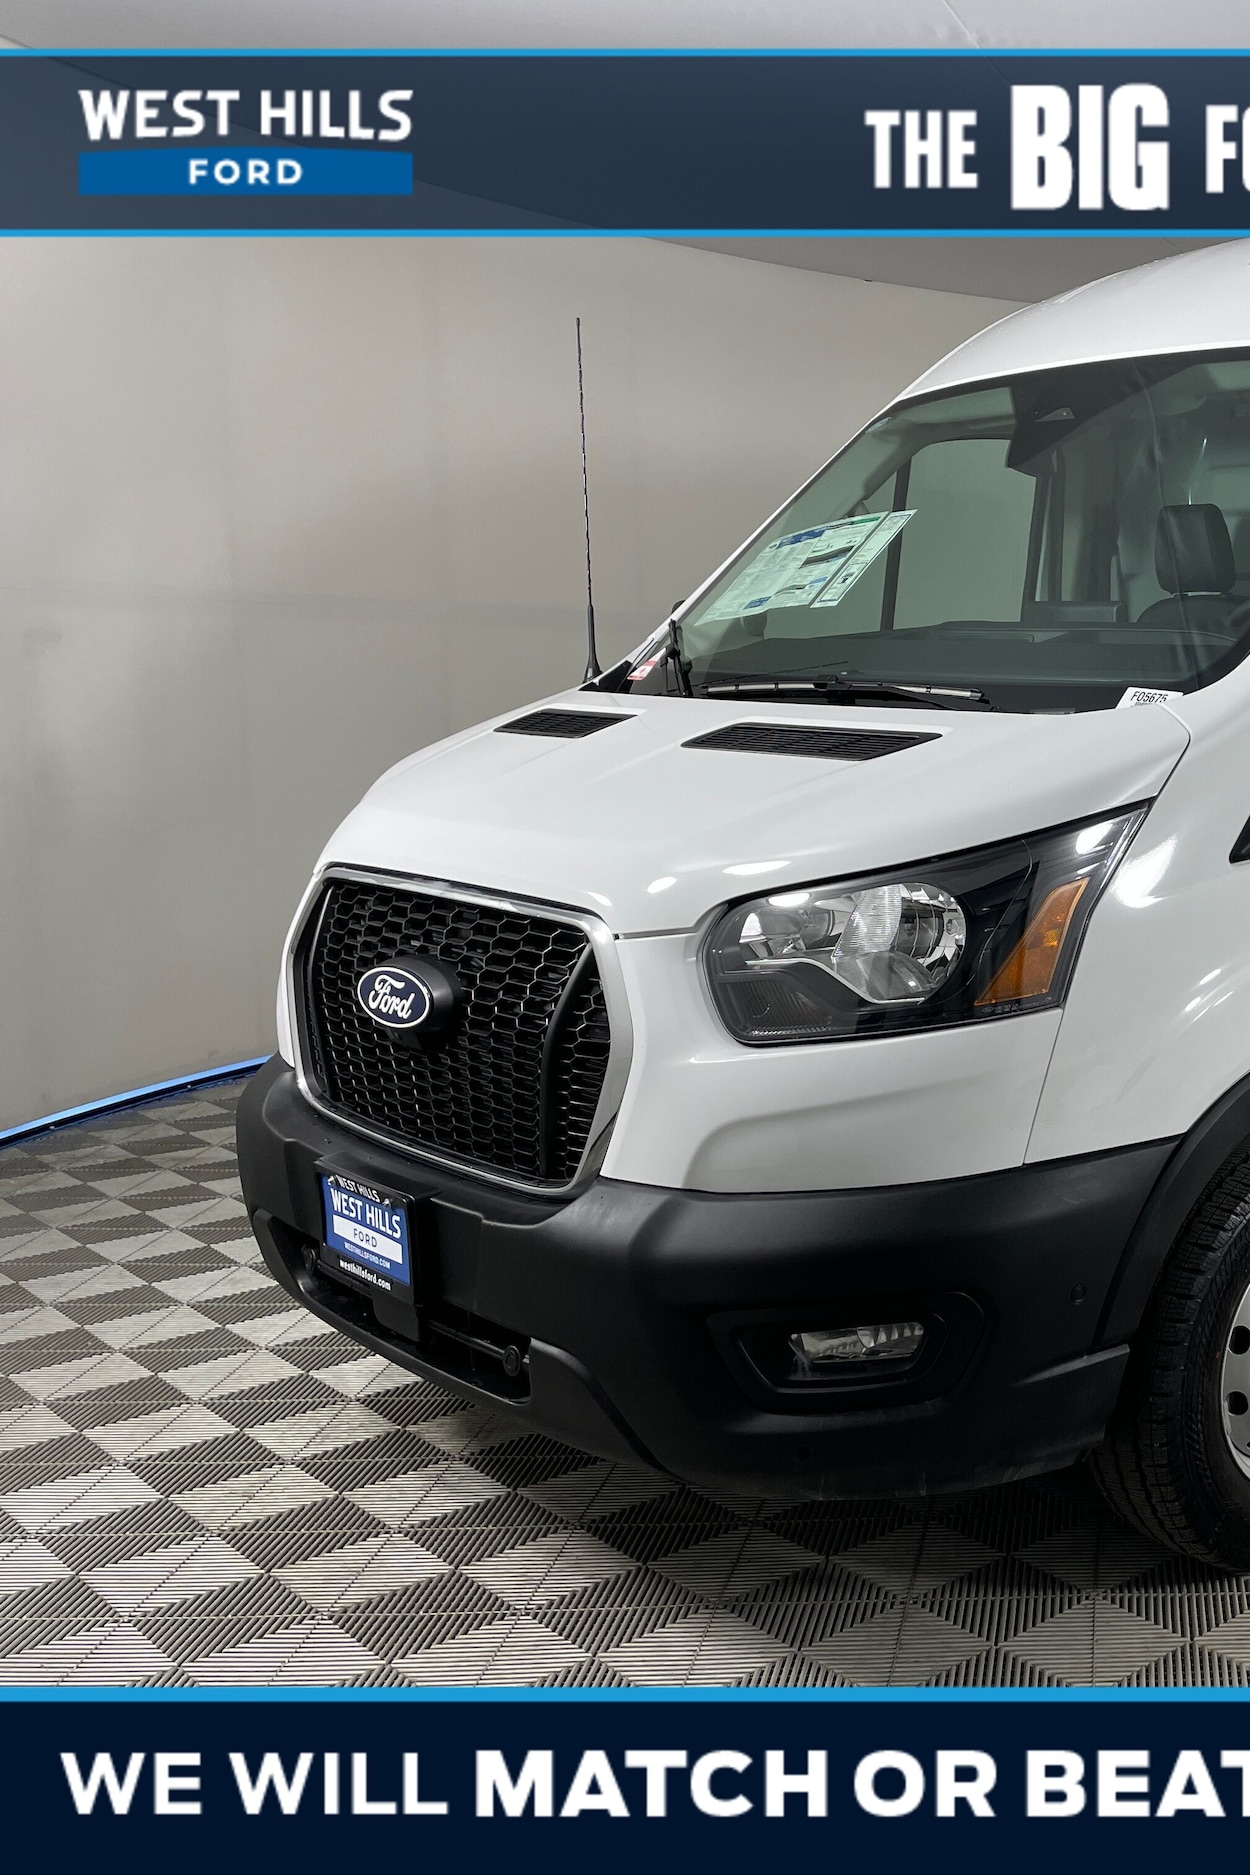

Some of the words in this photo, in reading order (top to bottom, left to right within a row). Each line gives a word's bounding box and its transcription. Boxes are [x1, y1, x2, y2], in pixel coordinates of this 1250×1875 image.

[368, 974, 415, 1018] Ford
[336, 1174, 357, 1193] WEST
[357, 1183, 380, 1202] HILLS
[330, 1188, 363, 1222] WEST
[366, 1203, 402, 1239] HILLS
[353, 1228, 378, 1248] FORD
[339, 1259, 391, 1290] westhillsford.com
